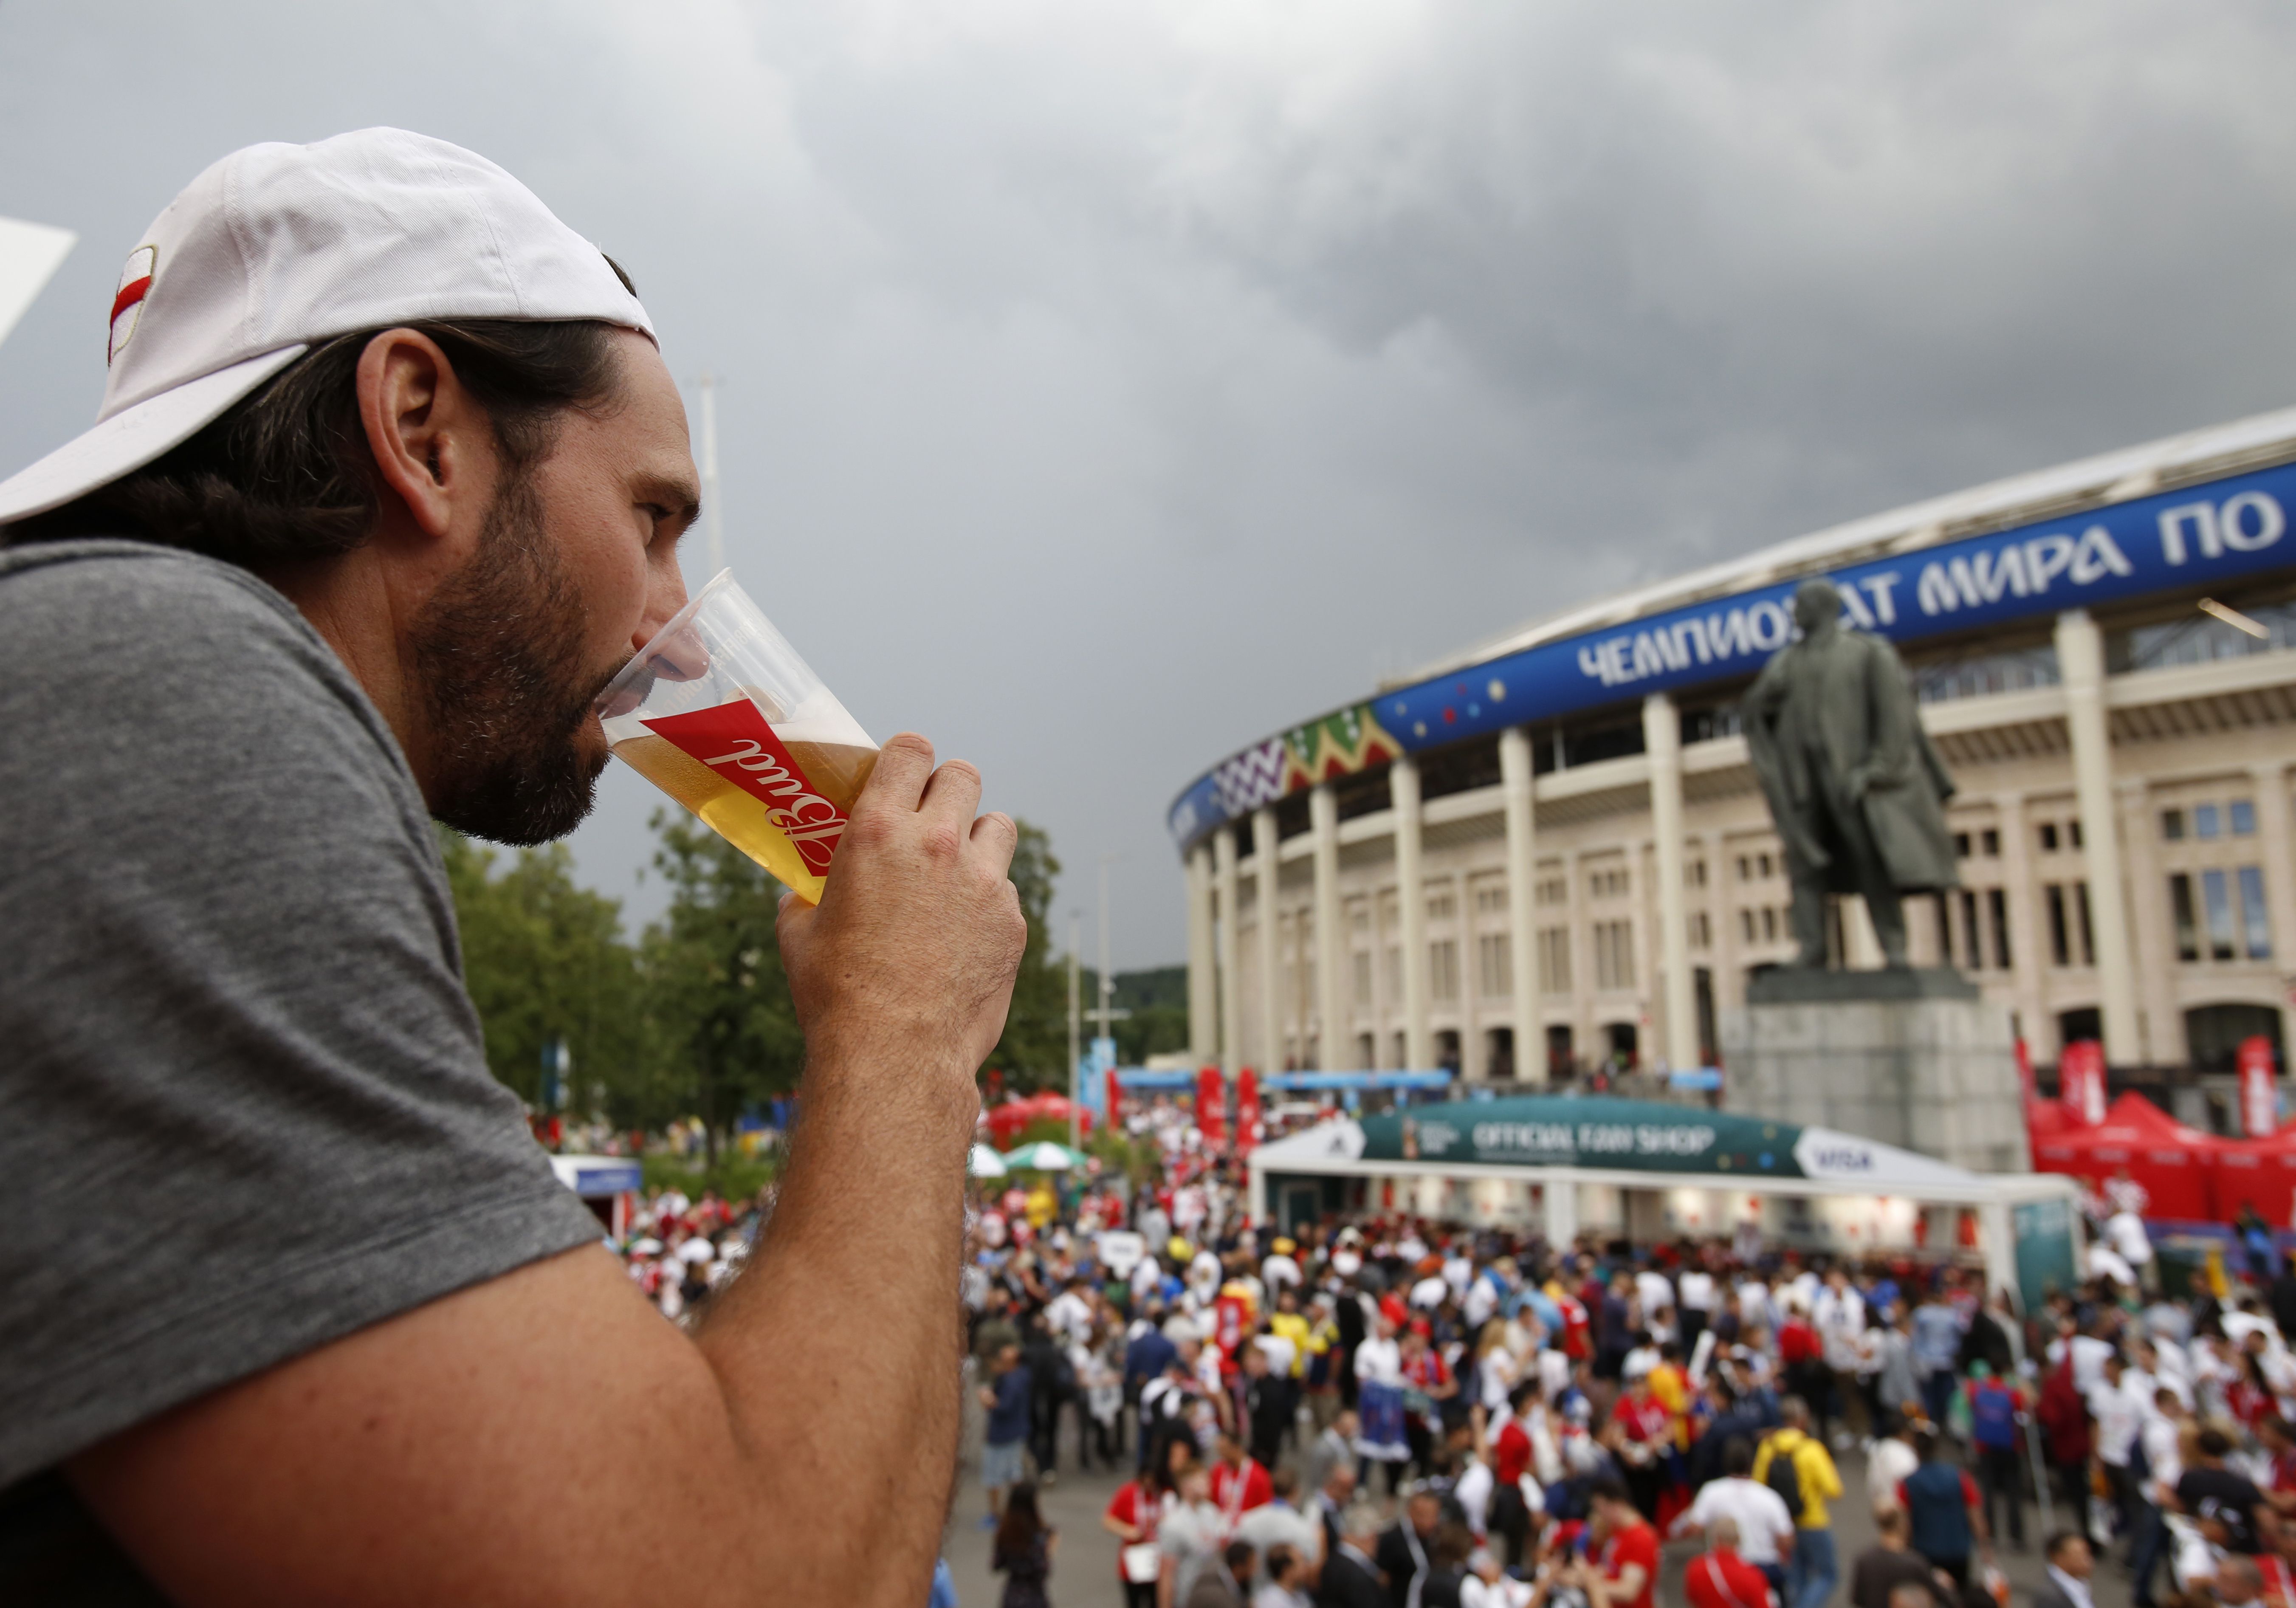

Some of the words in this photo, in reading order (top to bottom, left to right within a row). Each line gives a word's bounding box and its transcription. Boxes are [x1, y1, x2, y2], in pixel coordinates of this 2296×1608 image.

[1577, 572, 1900, 686] ЧЕМПИОАТ
[1916, 524, 2134, 617] МИРА
[2157, 490, 2287, 567] ПО
[702, 739, 848, 867] Bud
[1472, 1121, 1574, 1150] OFFICIAL
[1577, 1122, 1633, 1154] FAN
[1636, 1124, 1716, 1156] SHOP
[1811, 1148, 1874, 1171] VISA
